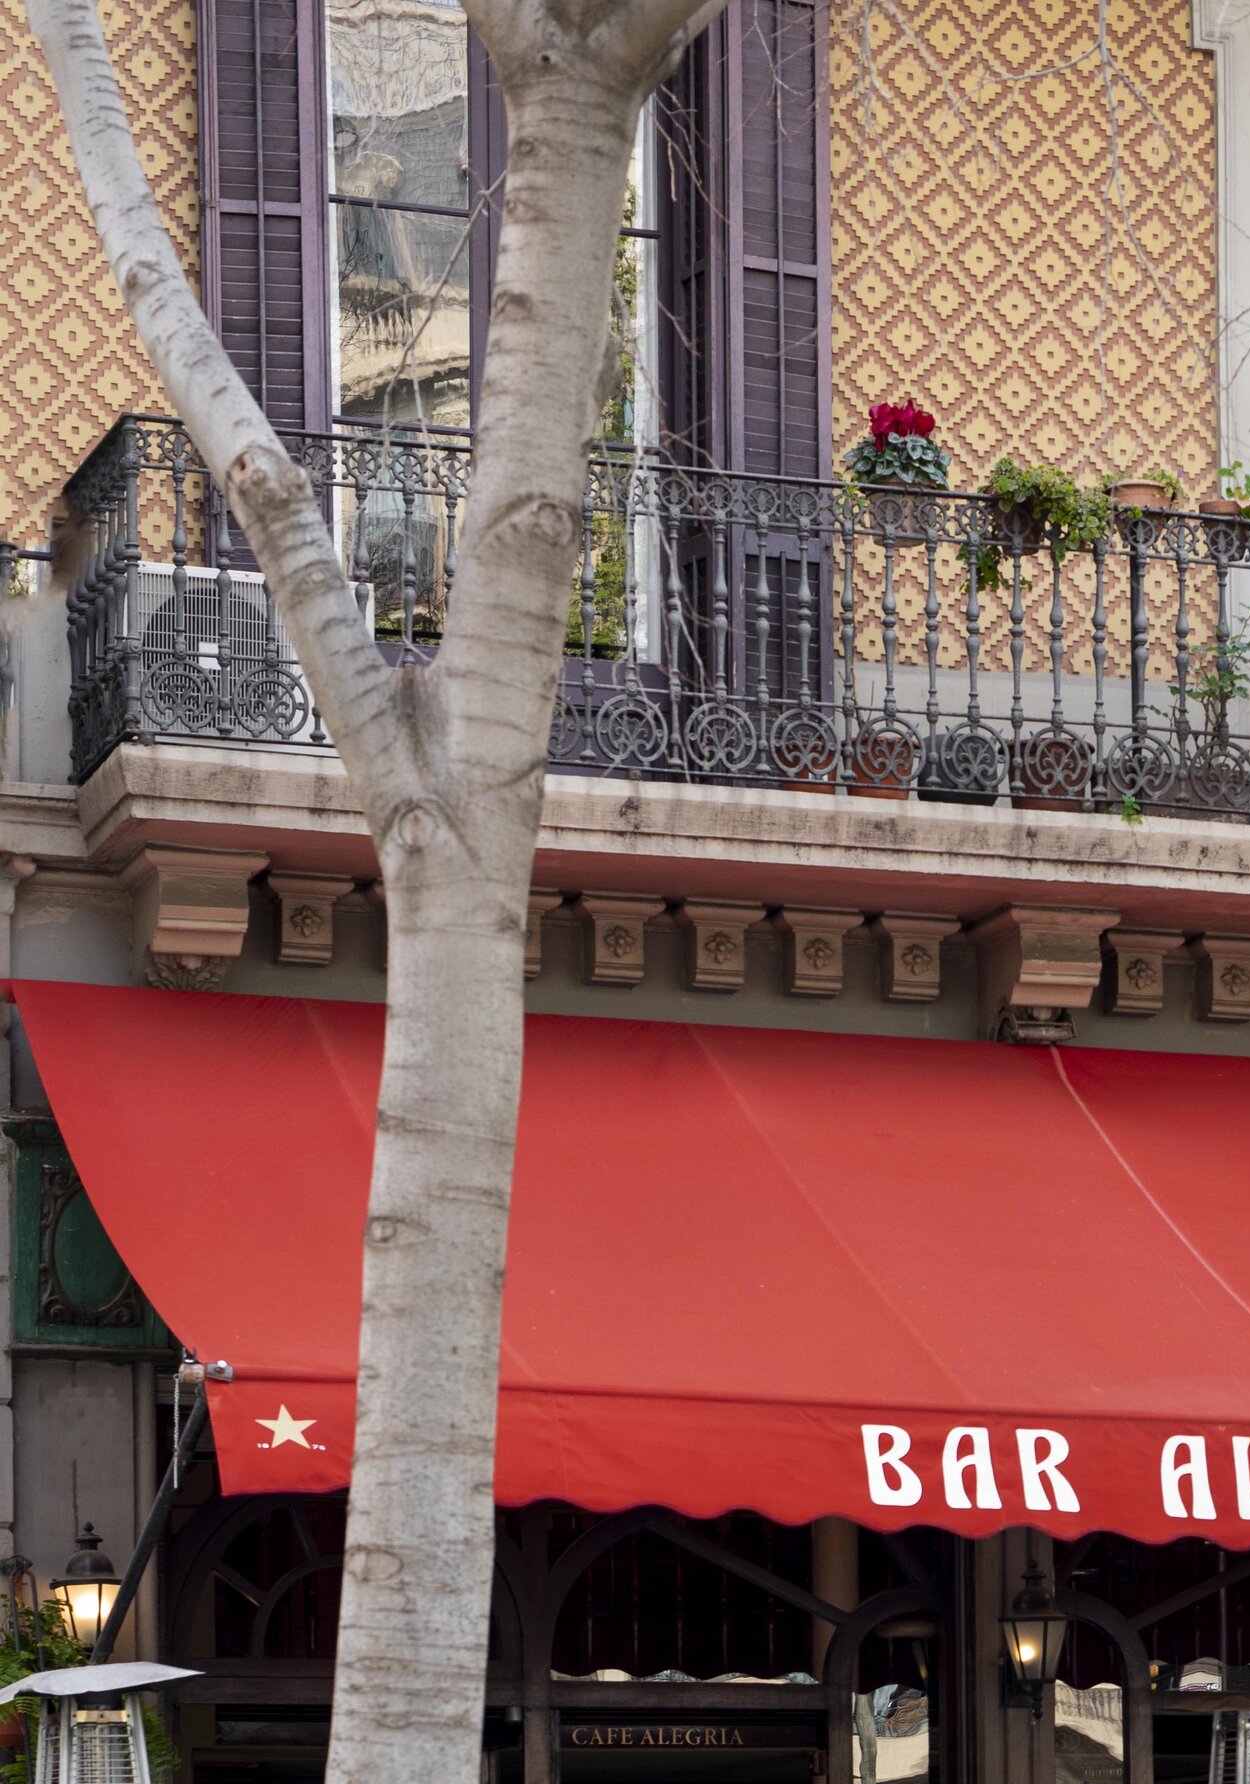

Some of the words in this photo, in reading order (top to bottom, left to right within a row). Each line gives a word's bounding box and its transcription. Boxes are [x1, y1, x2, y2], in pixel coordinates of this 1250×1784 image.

[861, 1424, 1081, 1513] BAR
[571, 1727, 634, 1746] CAFE
[640, 1727, 744, 1746] ALEGRIA
